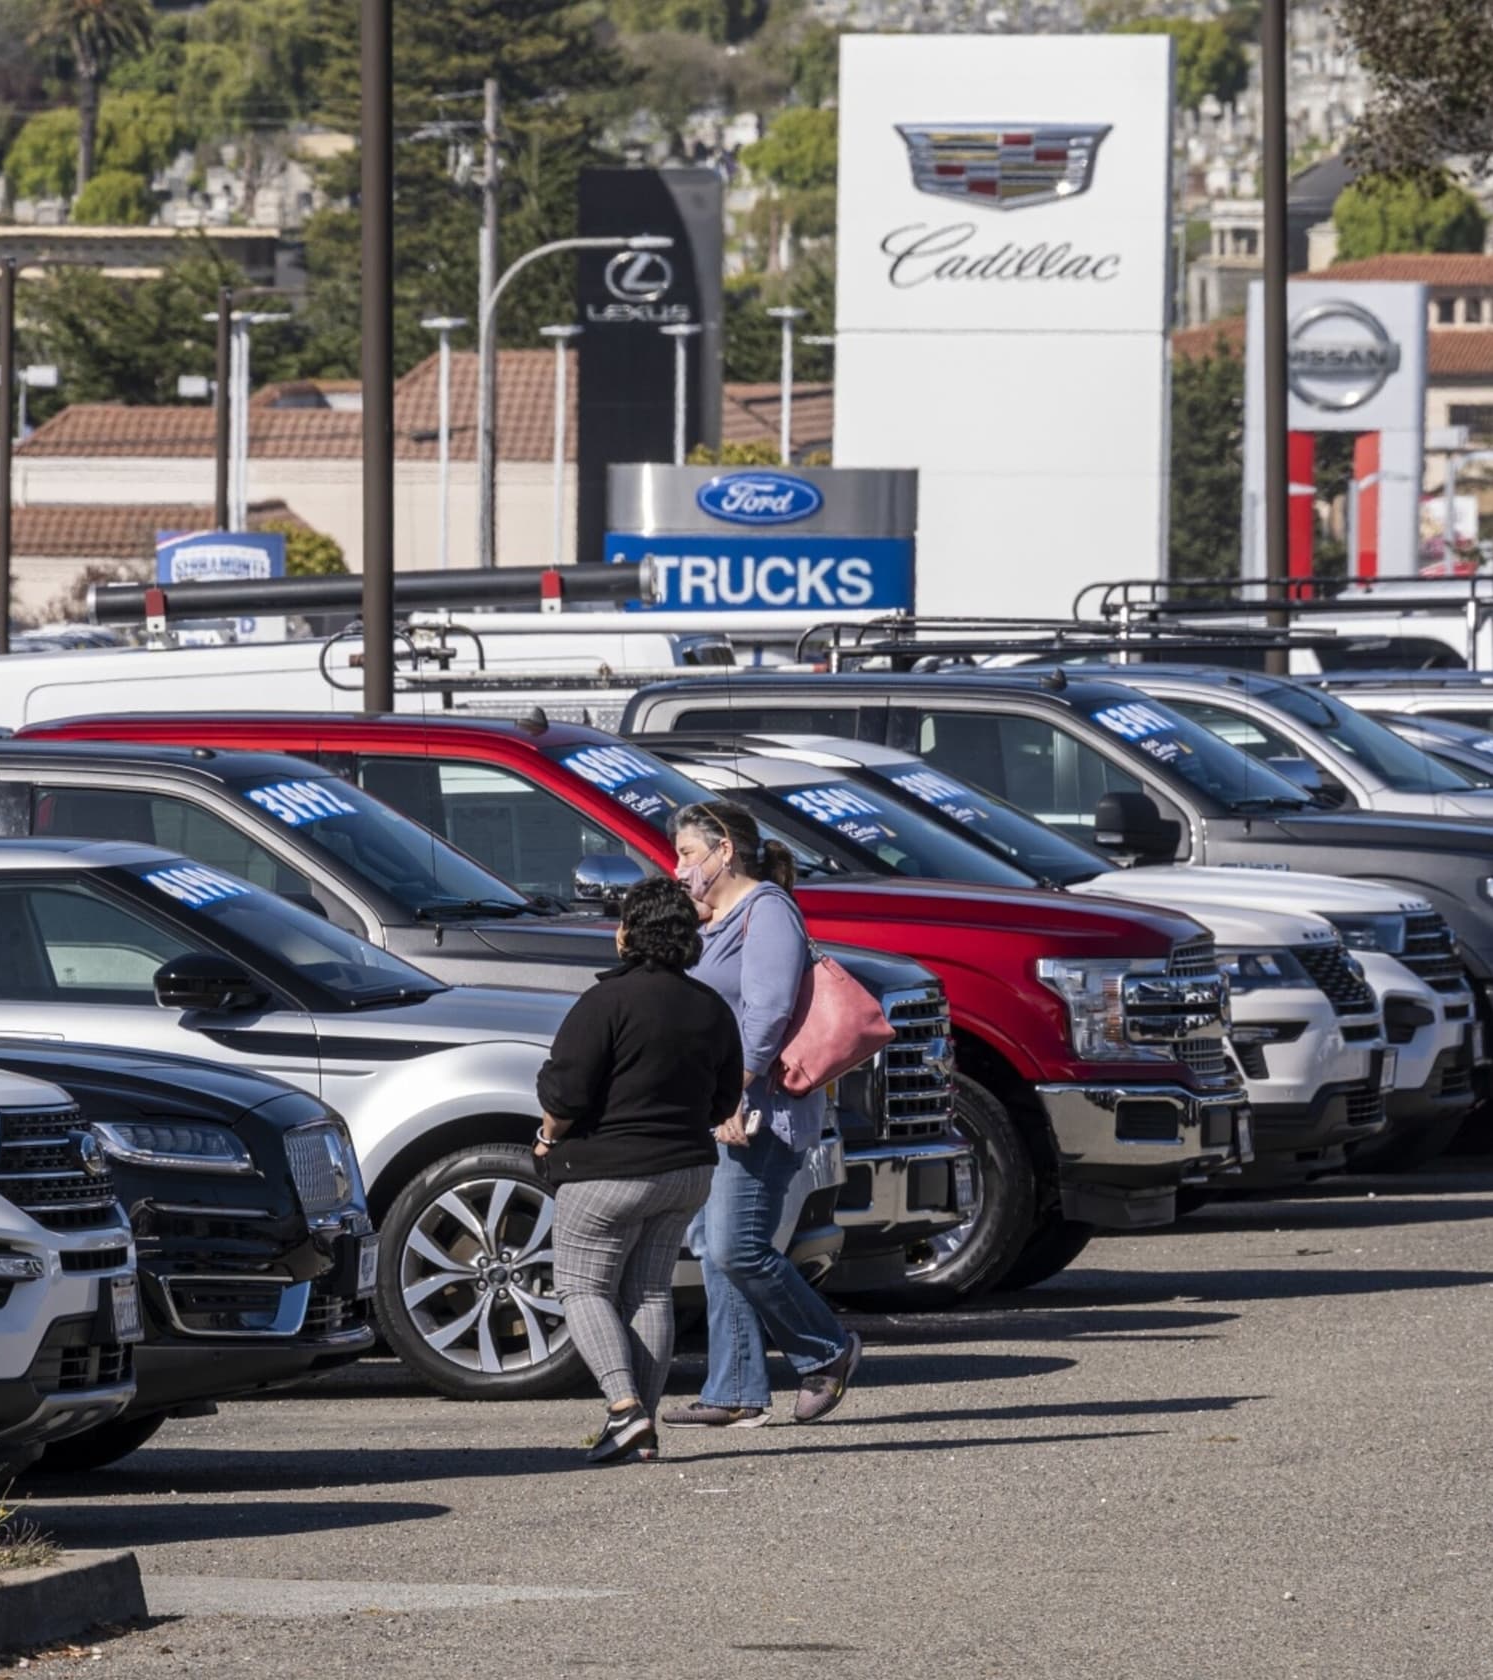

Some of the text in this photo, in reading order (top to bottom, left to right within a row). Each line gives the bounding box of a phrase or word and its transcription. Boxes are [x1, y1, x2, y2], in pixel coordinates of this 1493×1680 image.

[879, 222, 1122, 289] Cadillac
[586, 303, 690, 322] LEXUS
[721, 481, 794, 514] Ford
[654, 555, 875, 605] TRUCKS
